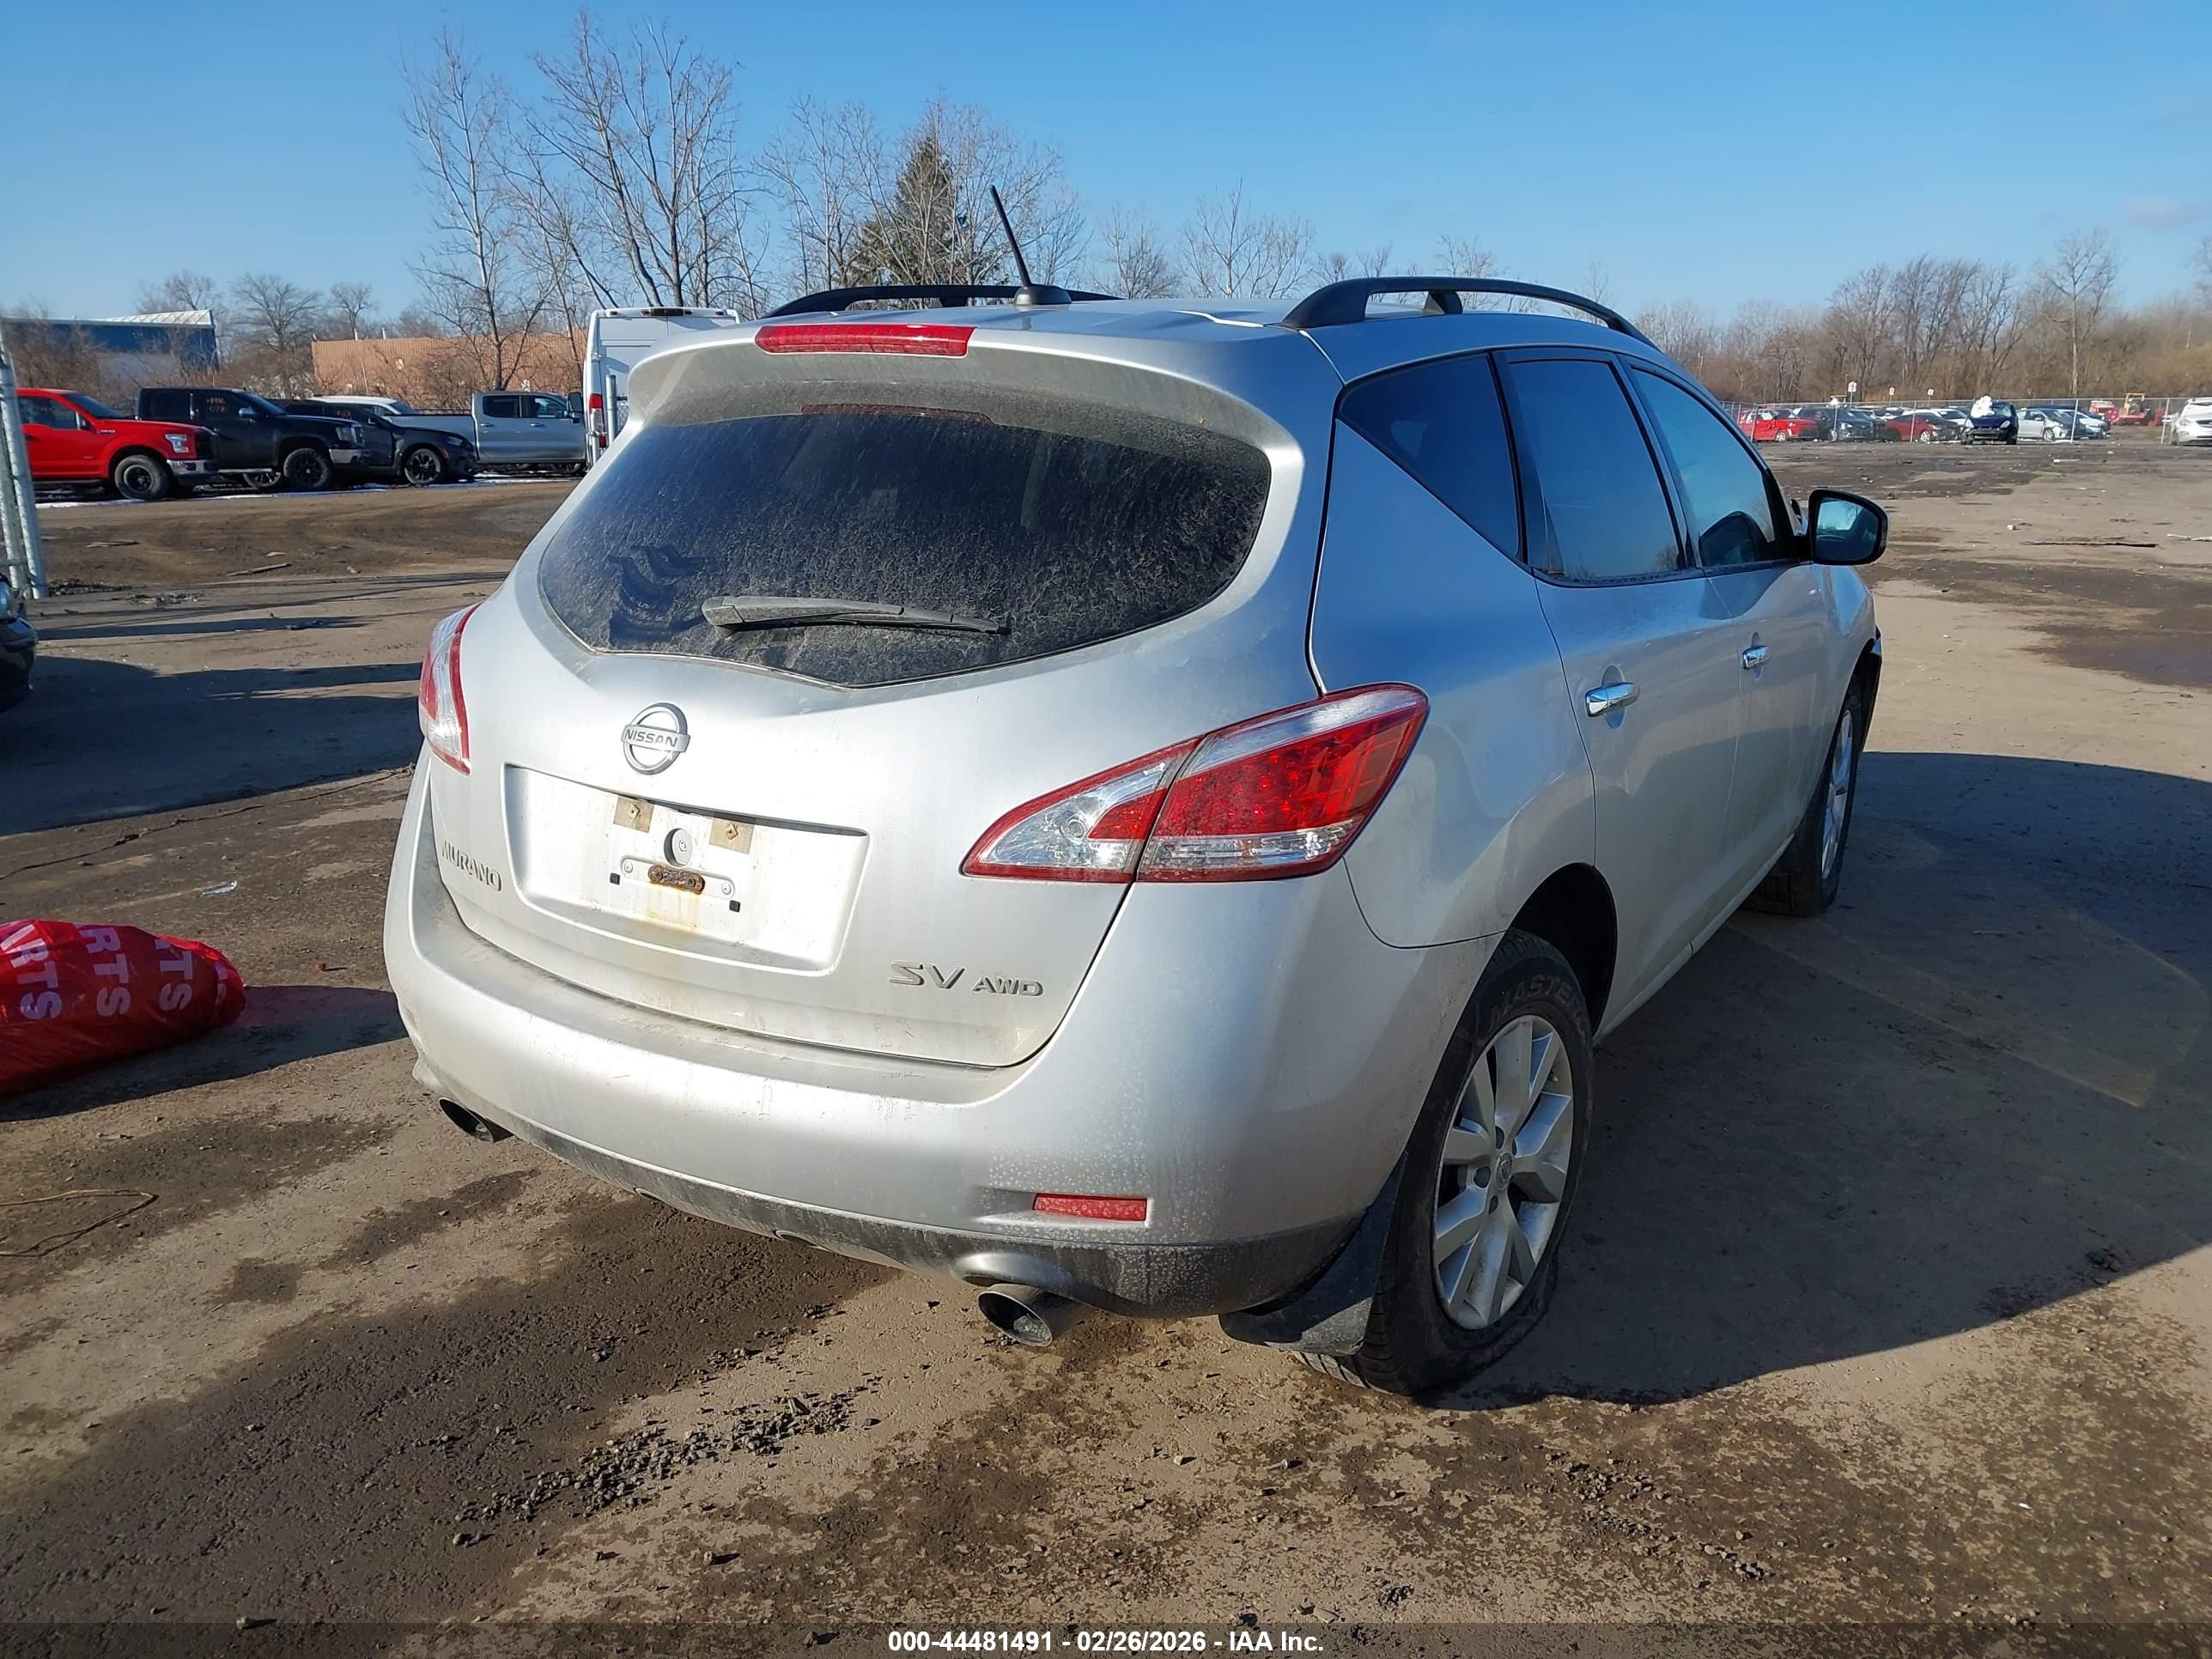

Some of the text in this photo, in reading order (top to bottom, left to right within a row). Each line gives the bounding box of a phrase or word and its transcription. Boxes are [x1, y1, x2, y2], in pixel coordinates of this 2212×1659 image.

[624, 729, 678, 748] NISSAN
[442, 839, 501, 892] MURANO
[888, 961, 1044, 996] SV AWD
